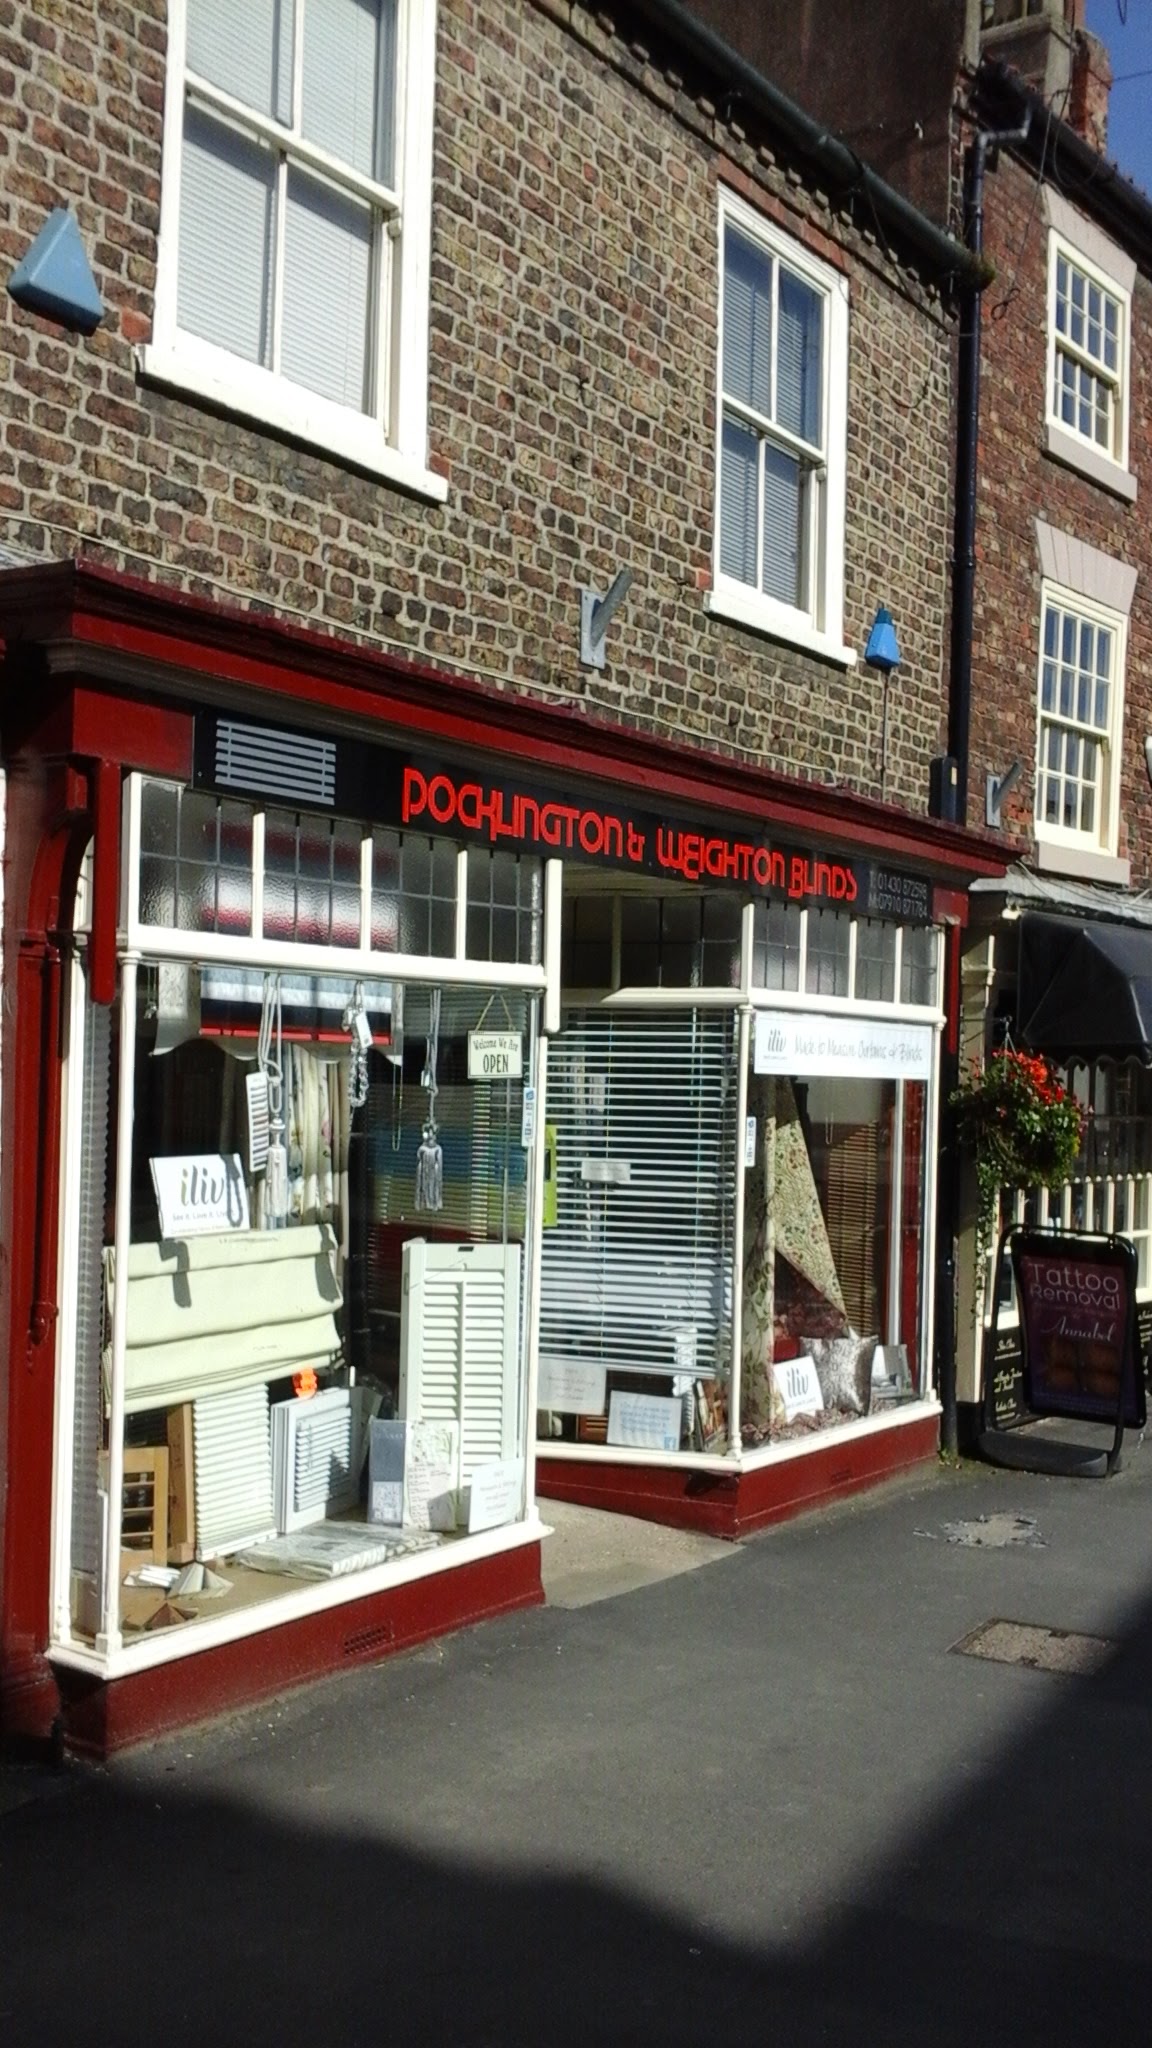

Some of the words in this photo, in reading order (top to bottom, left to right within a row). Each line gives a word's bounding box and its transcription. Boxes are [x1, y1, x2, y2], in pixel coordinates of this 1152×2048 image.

[402, 766, 623, 856] POCKLINGTON
[656, 827, 786, 884] WEIGHTON
[787, 856, 859, 901] BLINDS
[878, 872, 902, 894] 01430
[878, 892, 902, 913] 07910
[473, 1038, 497, 1051] Welcome
[498, 1037, 507, 1049] We
[508, 1039, 518, 1052] Are
[482, 1053, 509, 1073] OPEN
[180, 1164, 225, 1207] iliv
[1027, 1262, 1120, 1294] Tattoo
[1029, 1281, 1121, 1312] Removal
[785, 1366, 810, 1400] iliv
